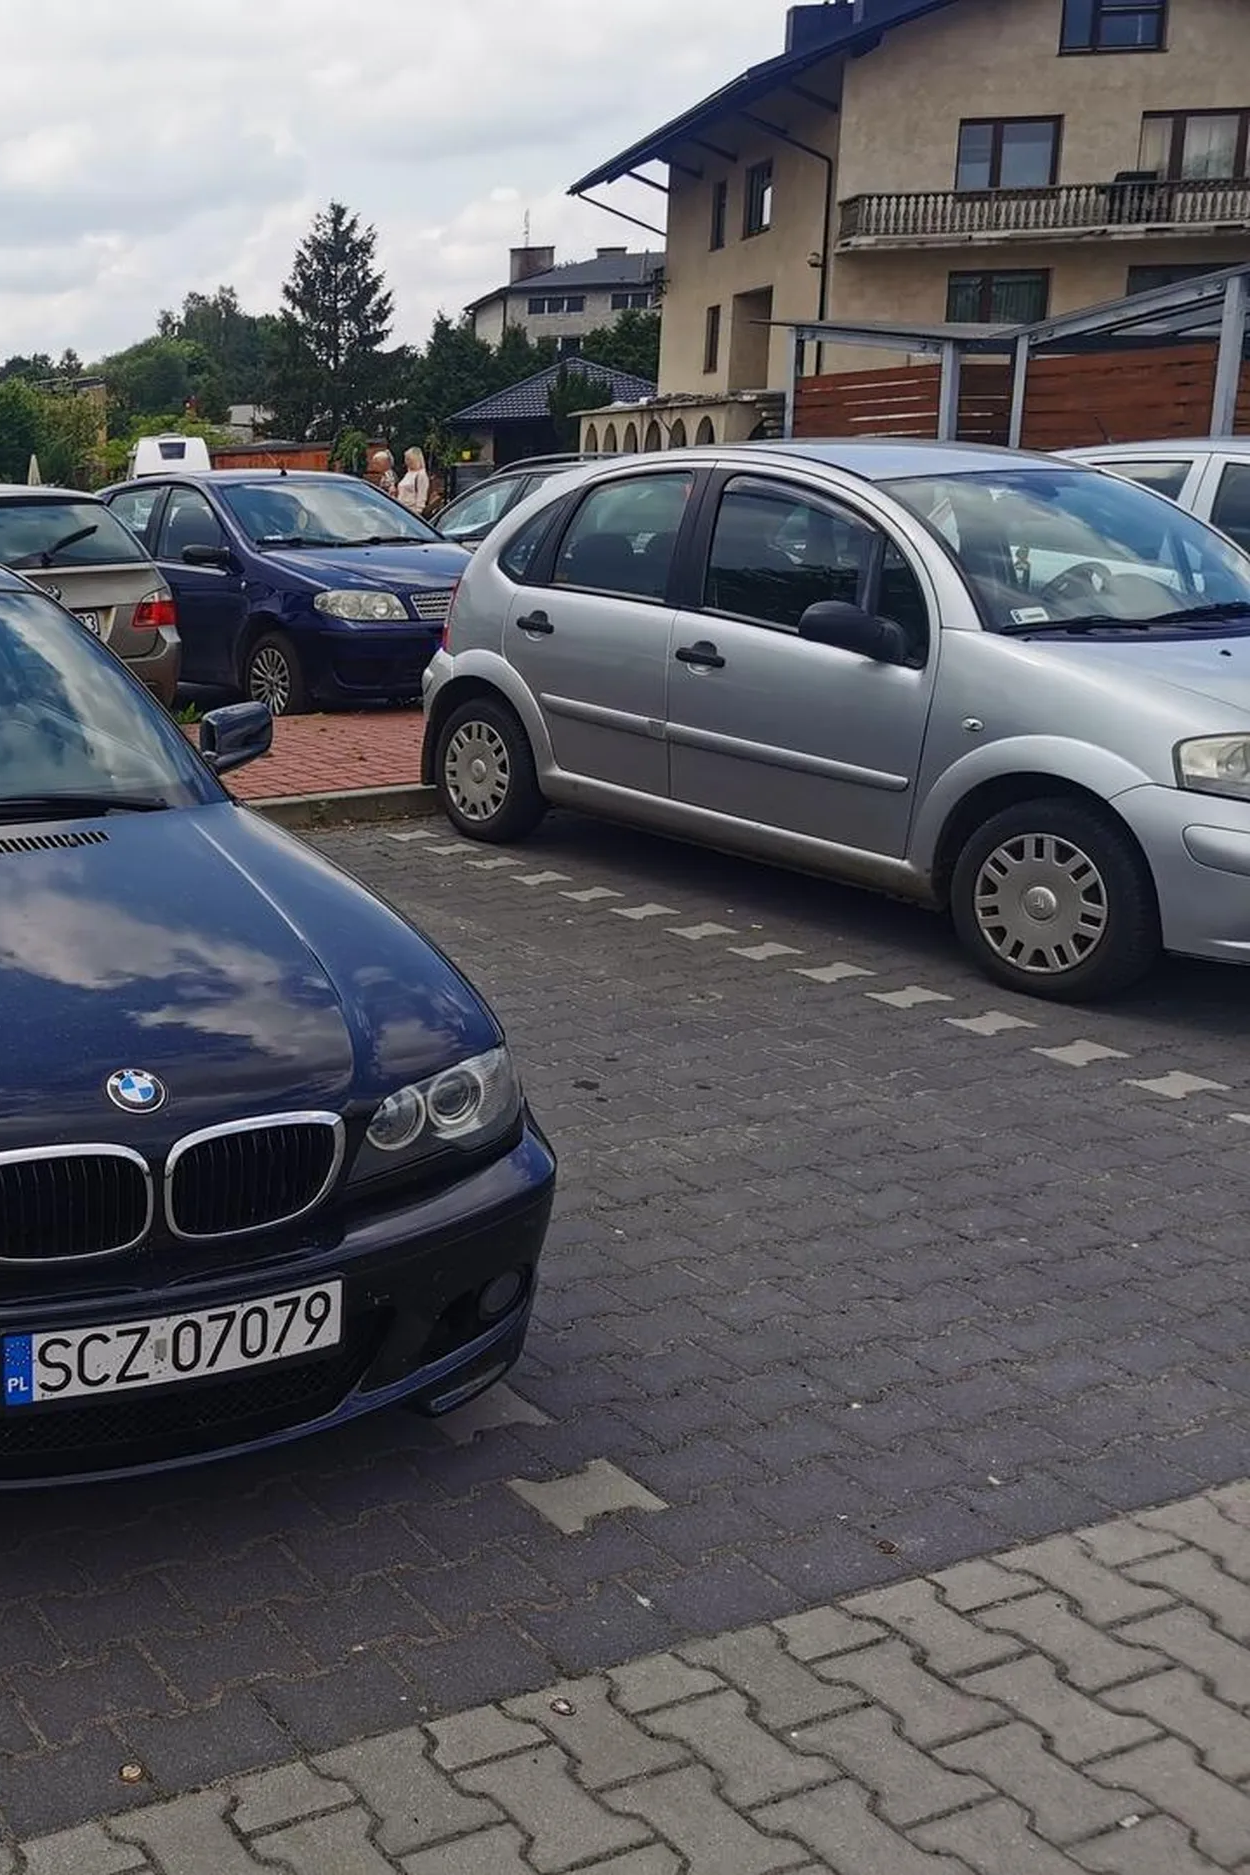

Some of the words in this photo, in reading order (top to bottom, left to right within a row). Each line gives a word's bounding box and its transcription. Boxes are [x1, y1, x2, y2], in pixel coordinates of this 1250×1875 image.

[37, 1326, 151, 1393] SCZ
[171, 1290, 332, 1373] 07079
[7, 1378, 29, 1393] PL
